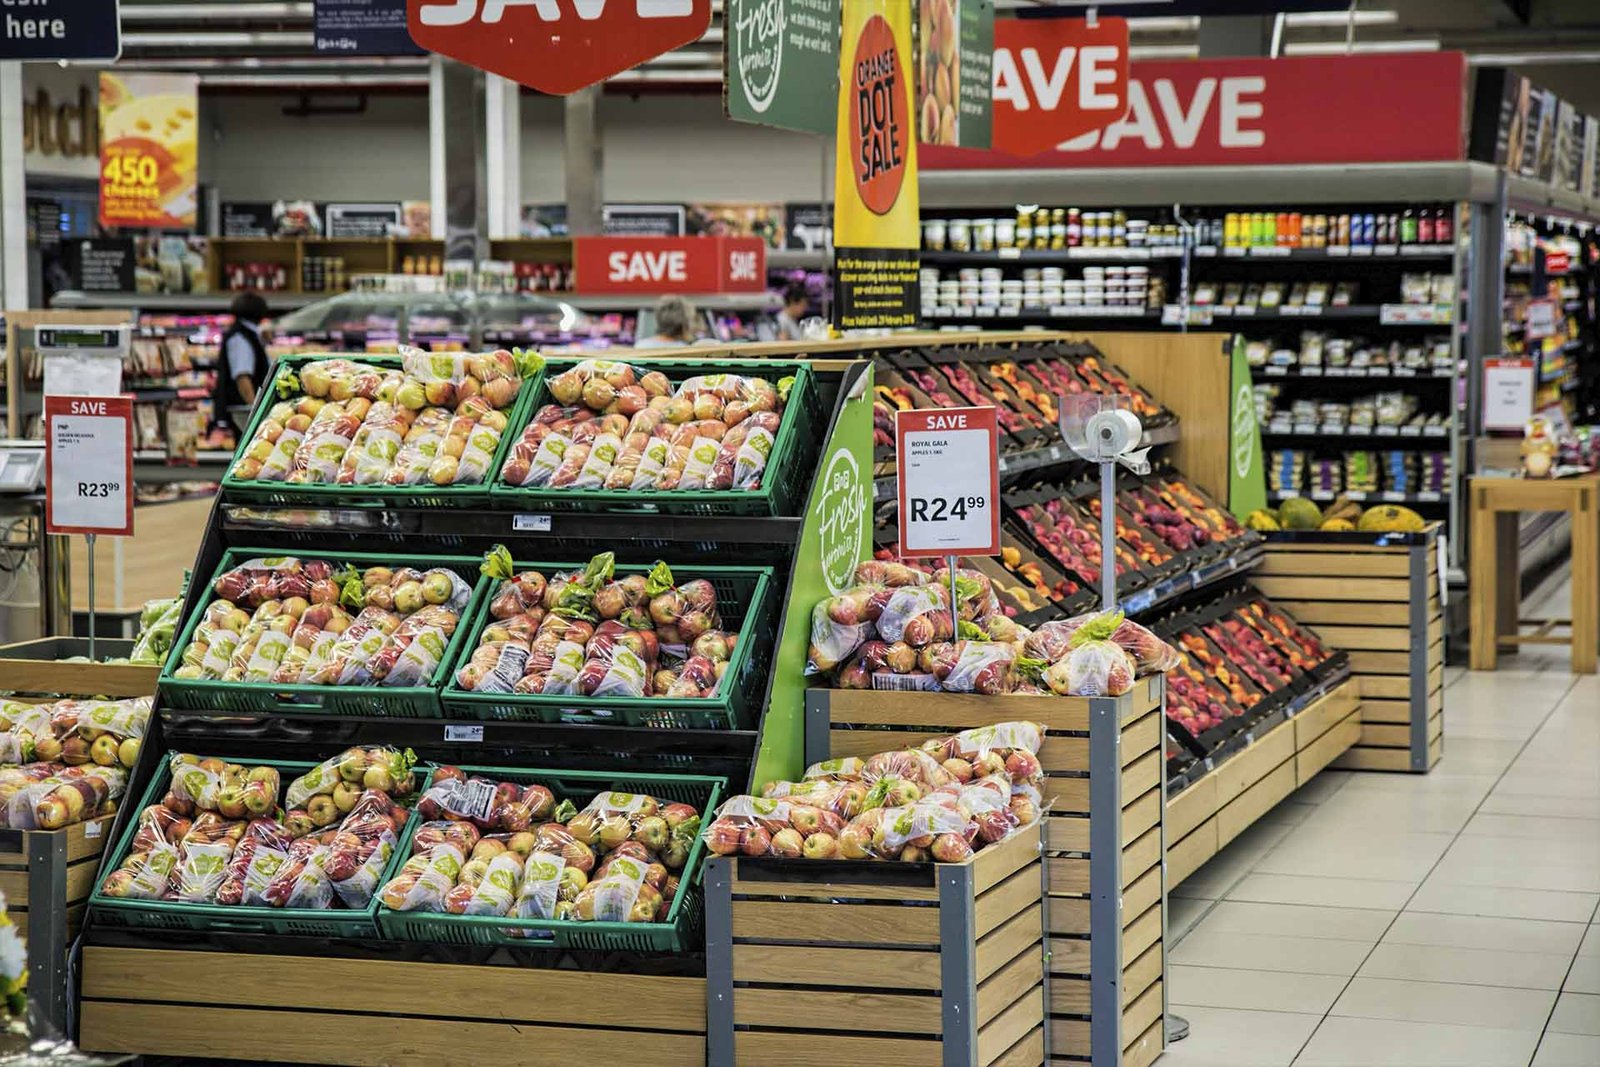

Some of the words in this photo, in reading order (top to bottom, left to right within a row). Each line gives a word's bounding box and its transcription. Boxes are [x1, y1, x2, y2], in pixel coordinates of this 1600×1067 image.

[6, 13, 66, 39] here
[857, 49, 895, 88] ORANGE
[992, 46, 1119, 111] AVE
[858, 74, 896, 139] DOT
[1056, 76, 1267, 151] AVE
[860, 124, 903, 184] SALE
[104, 155, 158, 187] 450
[608, 251, 687, 282] SAVE
[71, 401, 107, 415] SAVE
[926, 415, 967, 430] SAVE
[78, 482, 120, 498] R2399
[816, 483, 867, 544] Fresh
[911, 496, 985, 522] R2499
